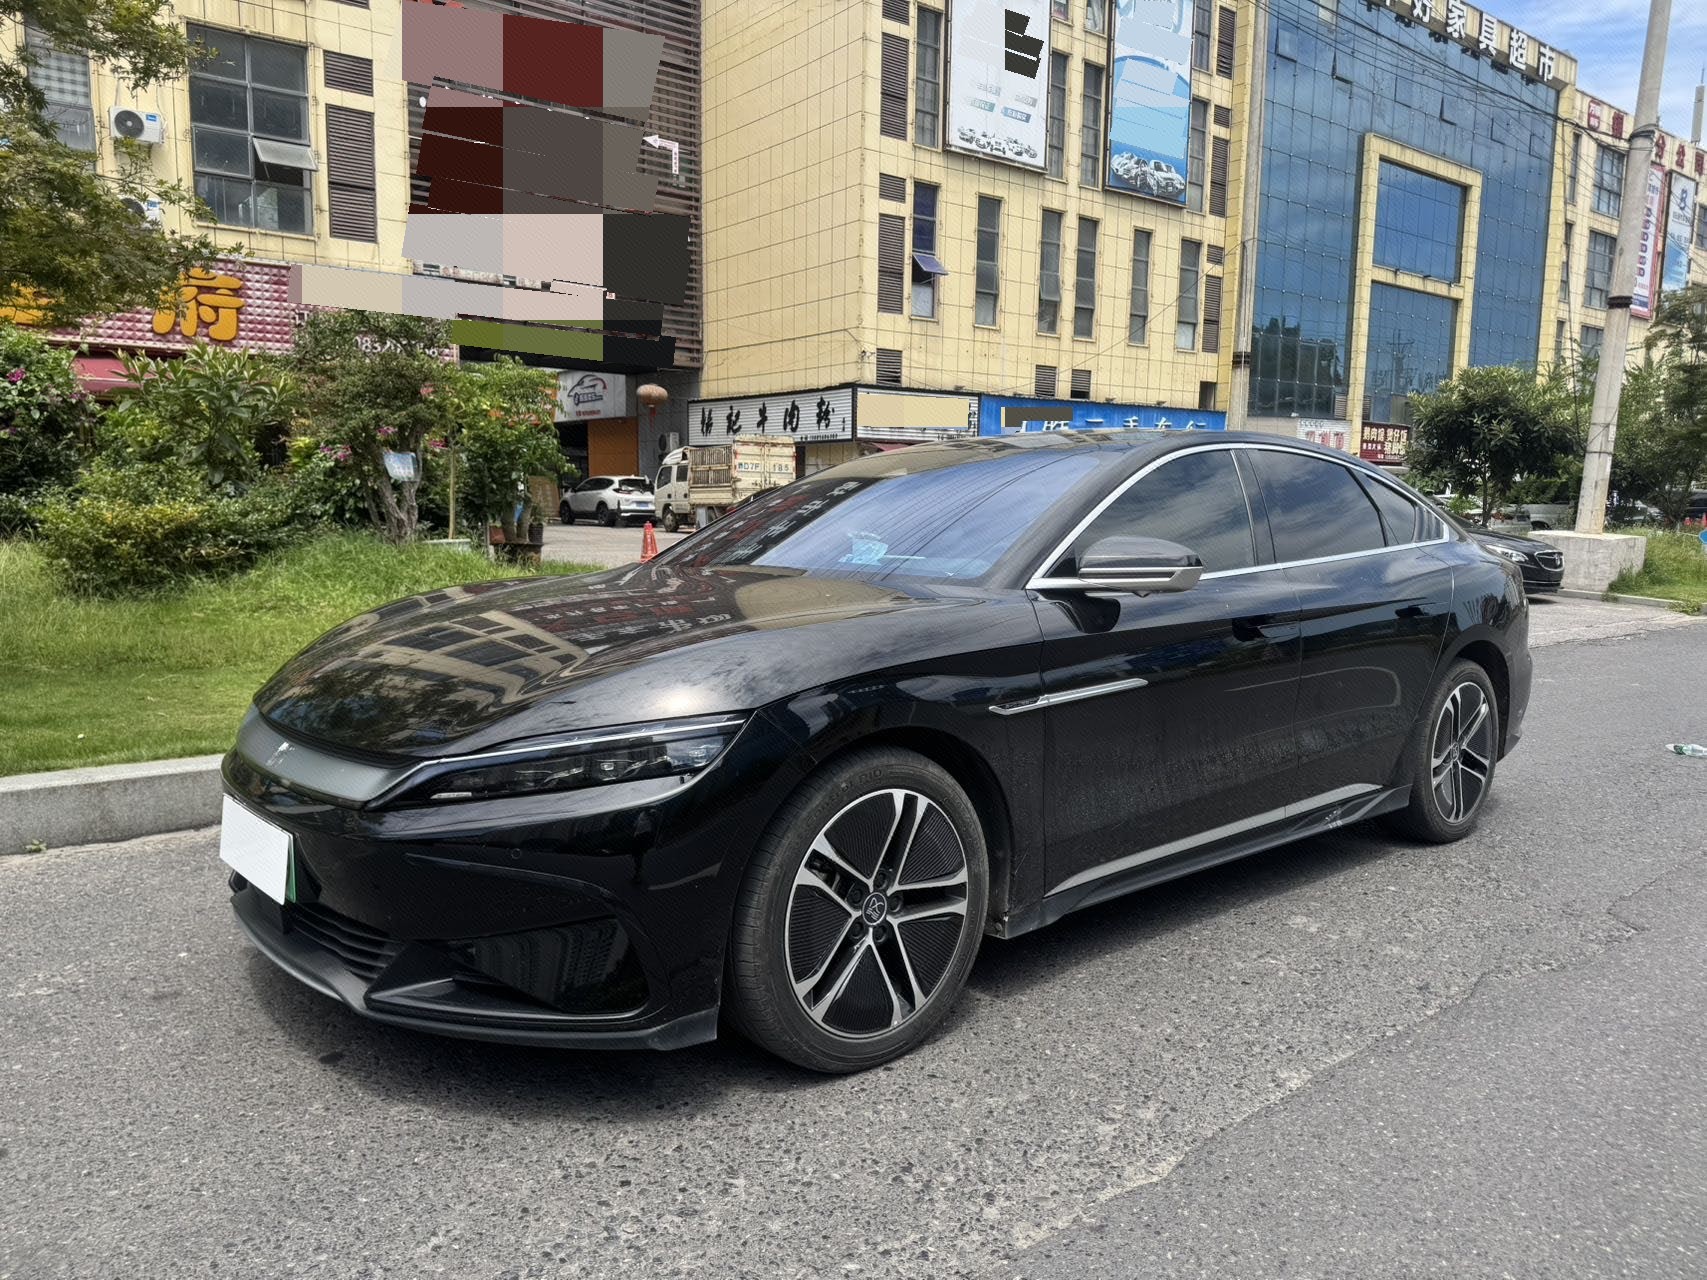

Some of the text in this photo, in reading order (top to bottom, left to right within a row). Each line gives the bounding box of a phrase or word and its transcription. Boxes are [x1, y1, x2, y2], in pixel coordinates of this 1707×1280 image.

[1385, 0, 1555, 82] 好家具超市
